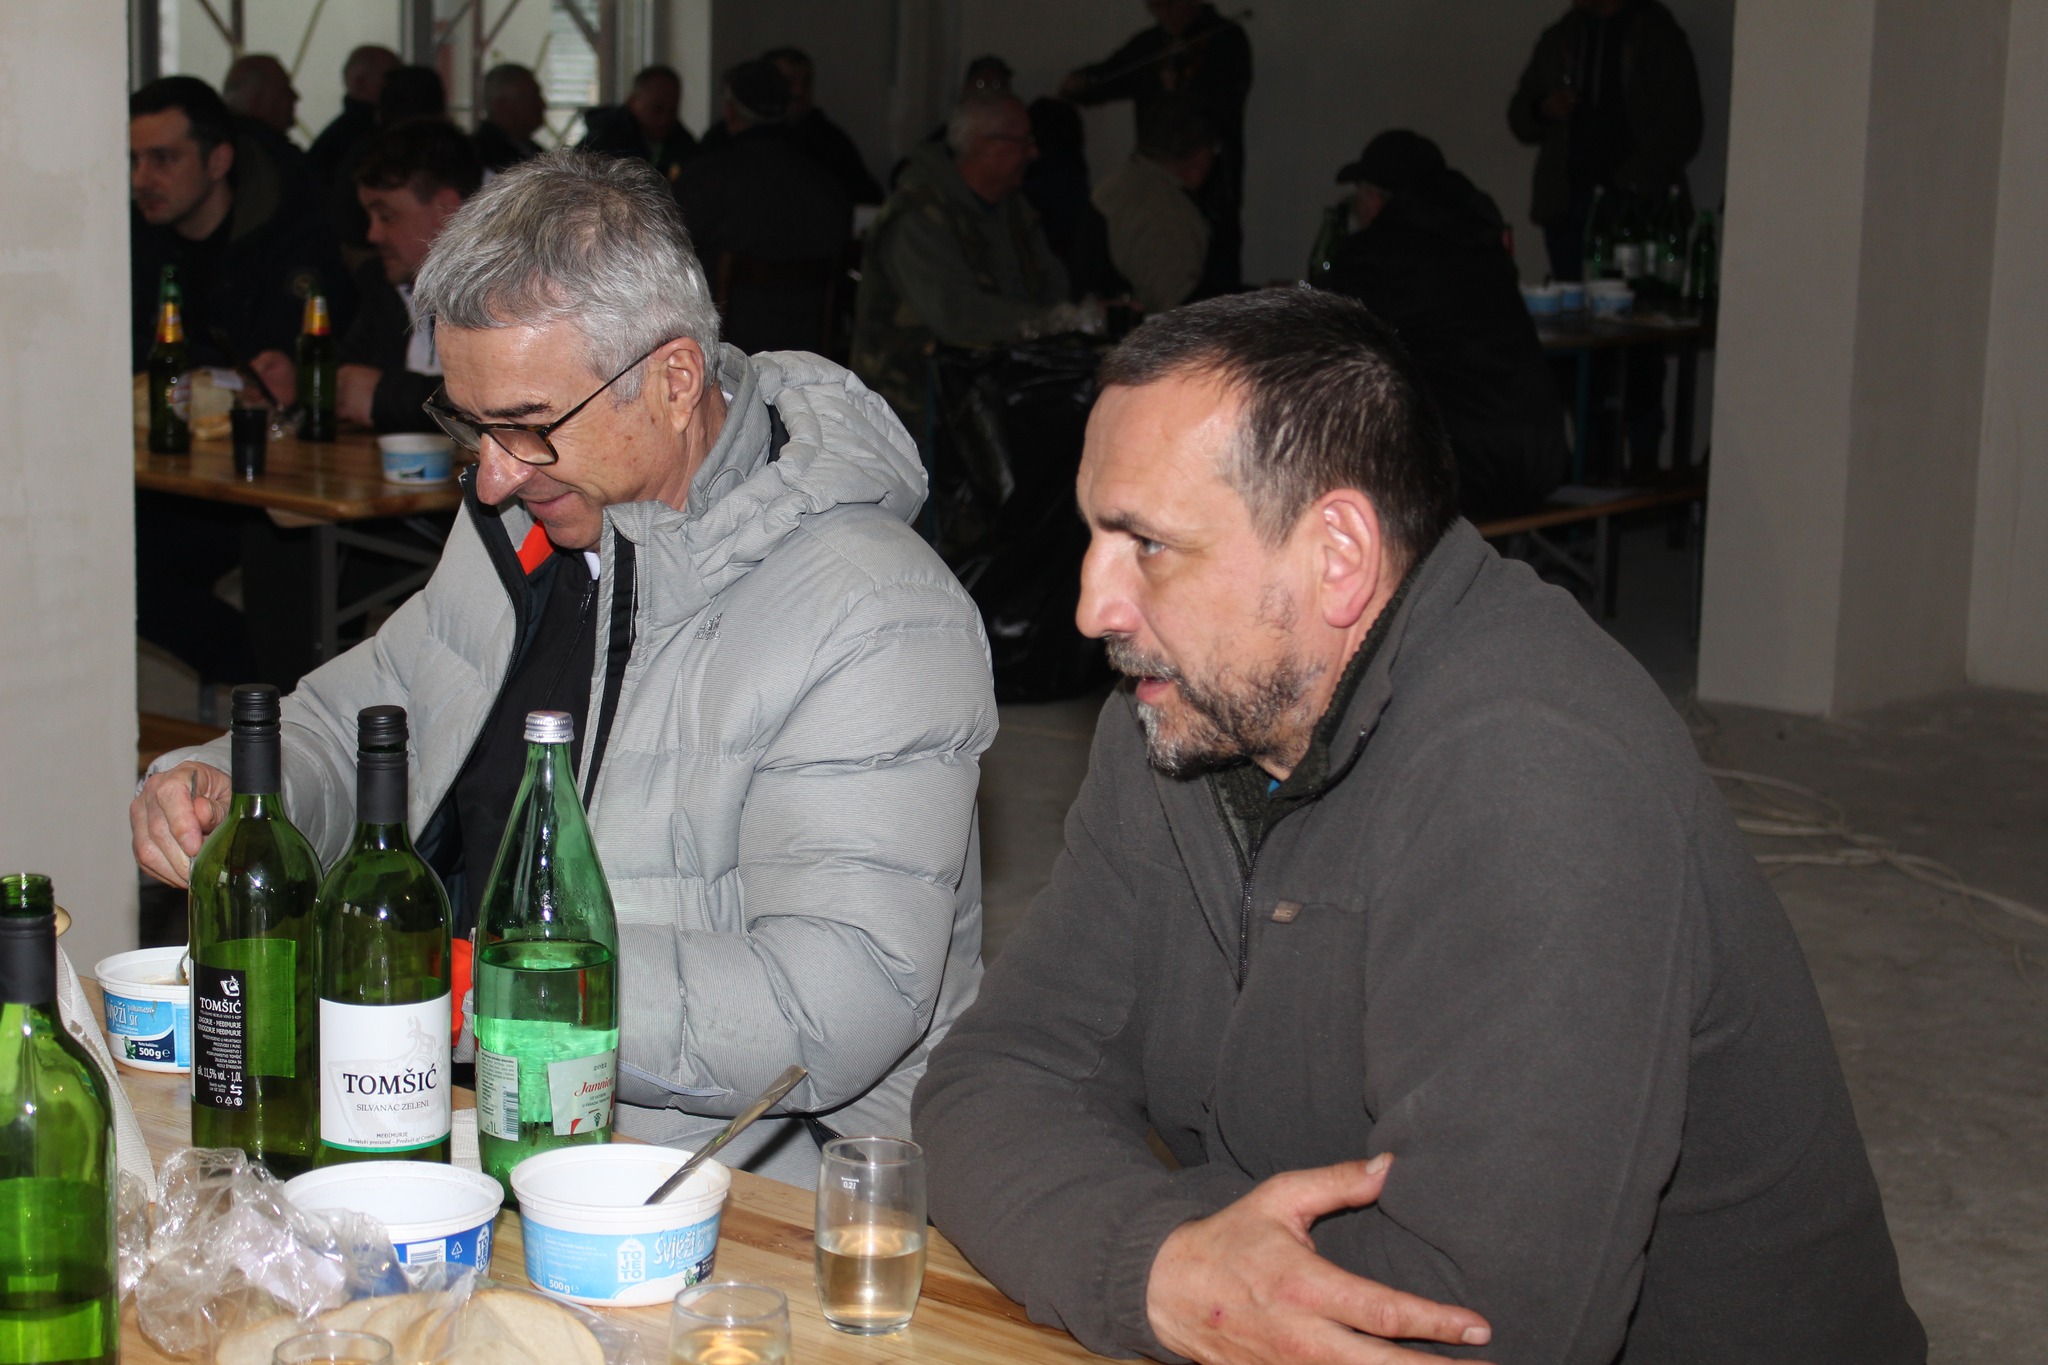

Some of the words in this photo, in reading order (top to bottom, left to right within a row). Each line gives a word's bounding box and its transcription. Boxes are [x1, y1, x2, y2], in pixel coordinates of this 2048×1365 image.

[200, 996, 242, 1014] TOMŠIĆ
[343, 1063, 437, 1095] TOMŠIĆ
[357, 1103, 400, 1112] SILVANAC
[401, 1100, 429, 1111] ZELENI
[621, 1251, 642, 1260] TO
[621, 1260, 642, 1269] JE
[621, 1270, 642, 1279] TO
